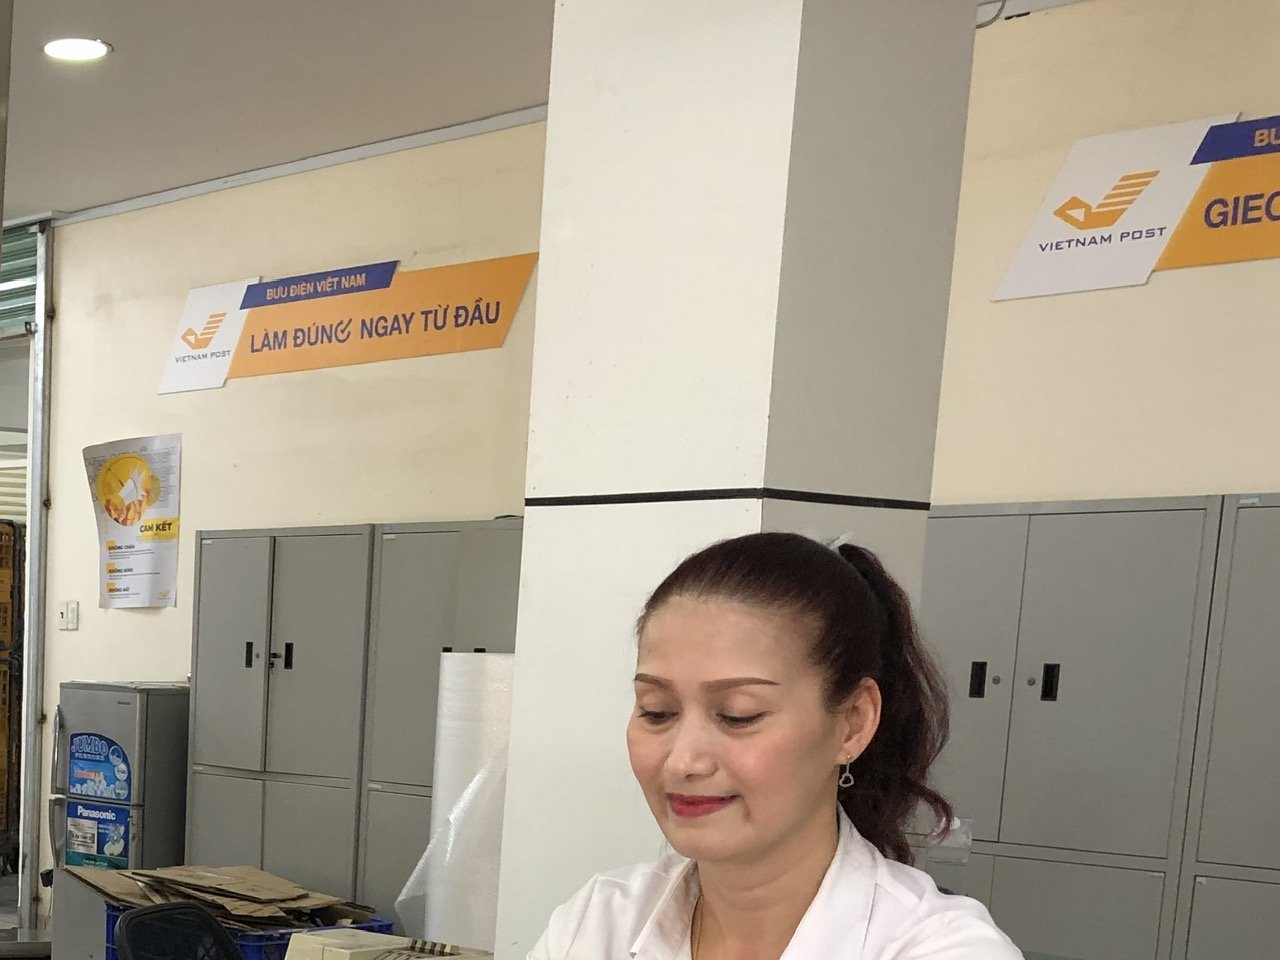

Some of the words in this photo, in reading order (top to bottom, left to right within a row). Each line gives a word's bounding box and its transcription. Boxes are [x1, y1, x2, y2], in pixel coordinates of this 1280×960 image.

[1039, 234, 1112, 252] VIETNAM
[1120, 227, 1167, 241] POST
[266, 284, 288, 300] BƯU
[290, 281, 314, 298] ĐIỆN
[316, 276, 339, 292] VIỆT
[341, 273, 366, 289] NAM
[250, 328, 287, 353] LÀM
[360, 312, 415, 339] NGAY
[421, 304, 449, 332] TỪ
[454, 297, 500, 328] ĐẦU
[175, 353, 208, 363] VIETNAM
[210, 350, 231, 358] POST
[139, 524, 154, 533] CAM
[155, 520, 173, 531] KẾT
[71, 735, 109, 756] JUMBO
[77, 805, 117, 820] Panasonic
